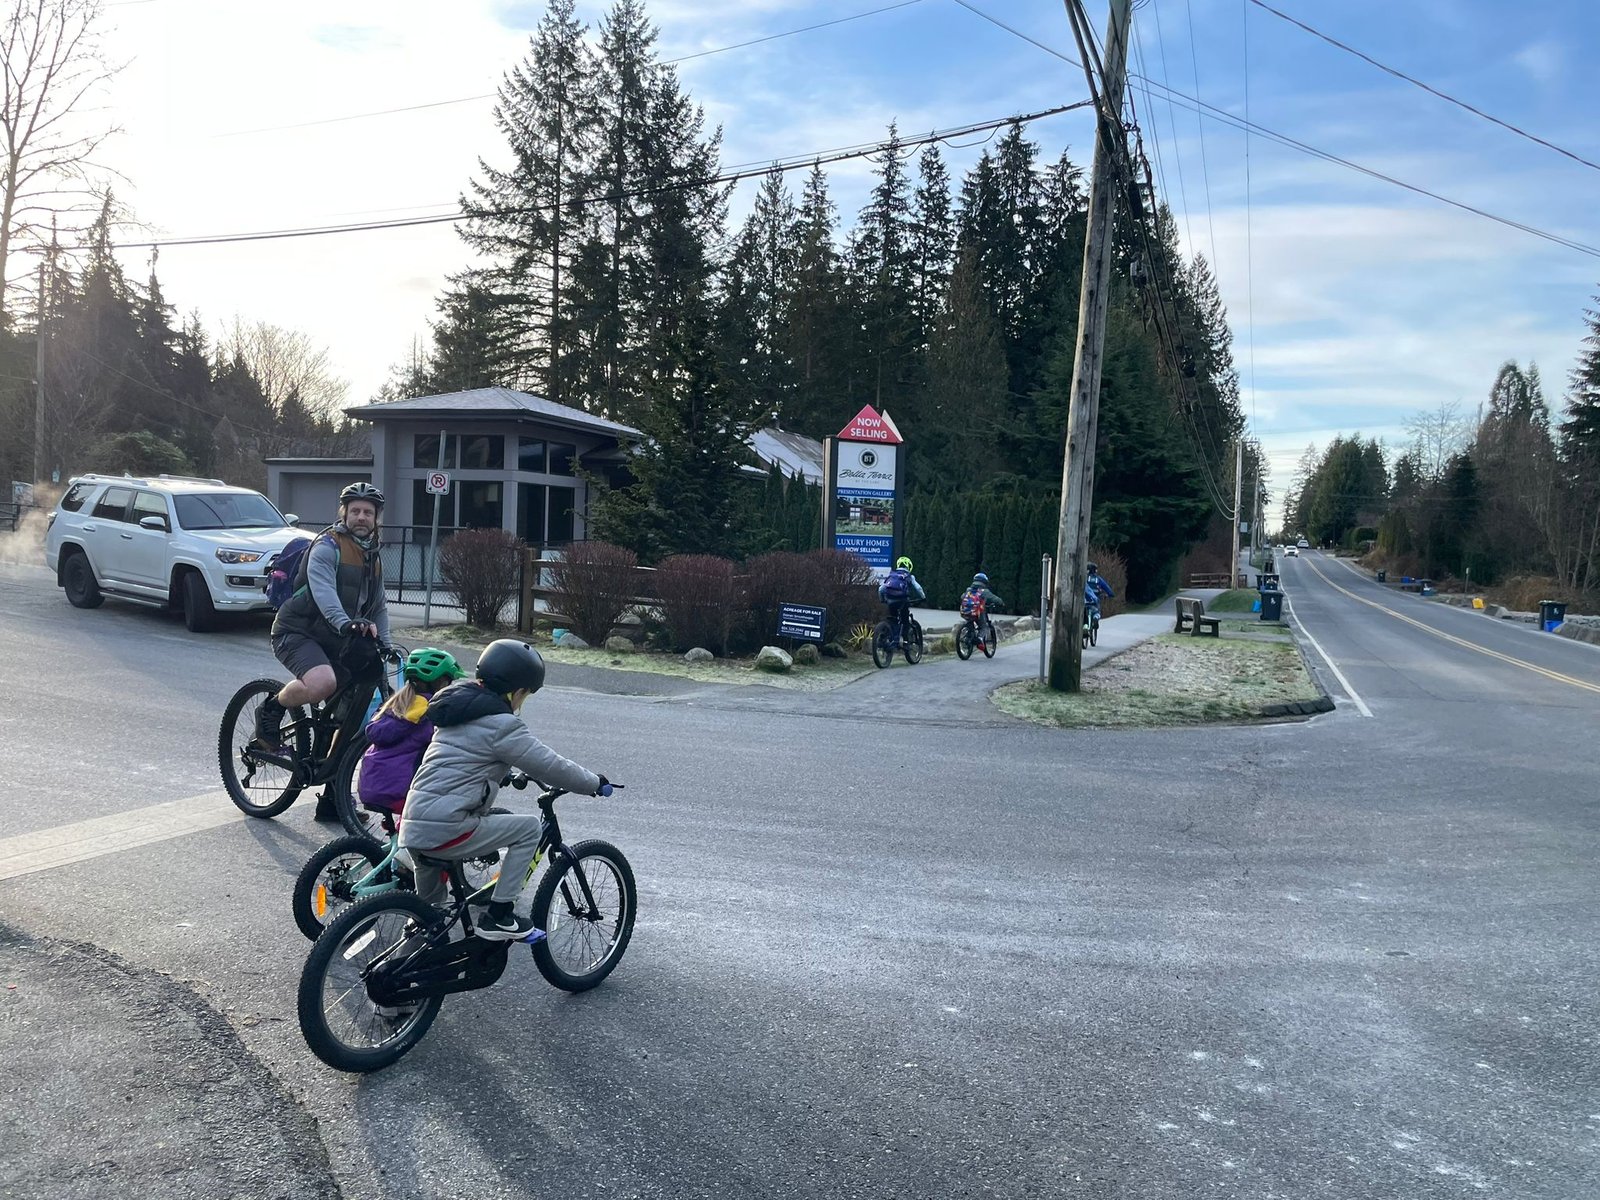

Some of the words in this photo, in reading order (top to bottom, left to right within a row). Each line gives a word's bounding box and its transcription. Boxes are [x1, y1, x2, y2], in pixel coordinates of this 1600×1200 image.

[857, 418, 880, 427] NOW
[850, 428, 887, 439] SELLING
[839, 469, 865, 478] Bella
[867, 471, 892, 480] Terra
[837, 538, 864, 546] LUXURY
